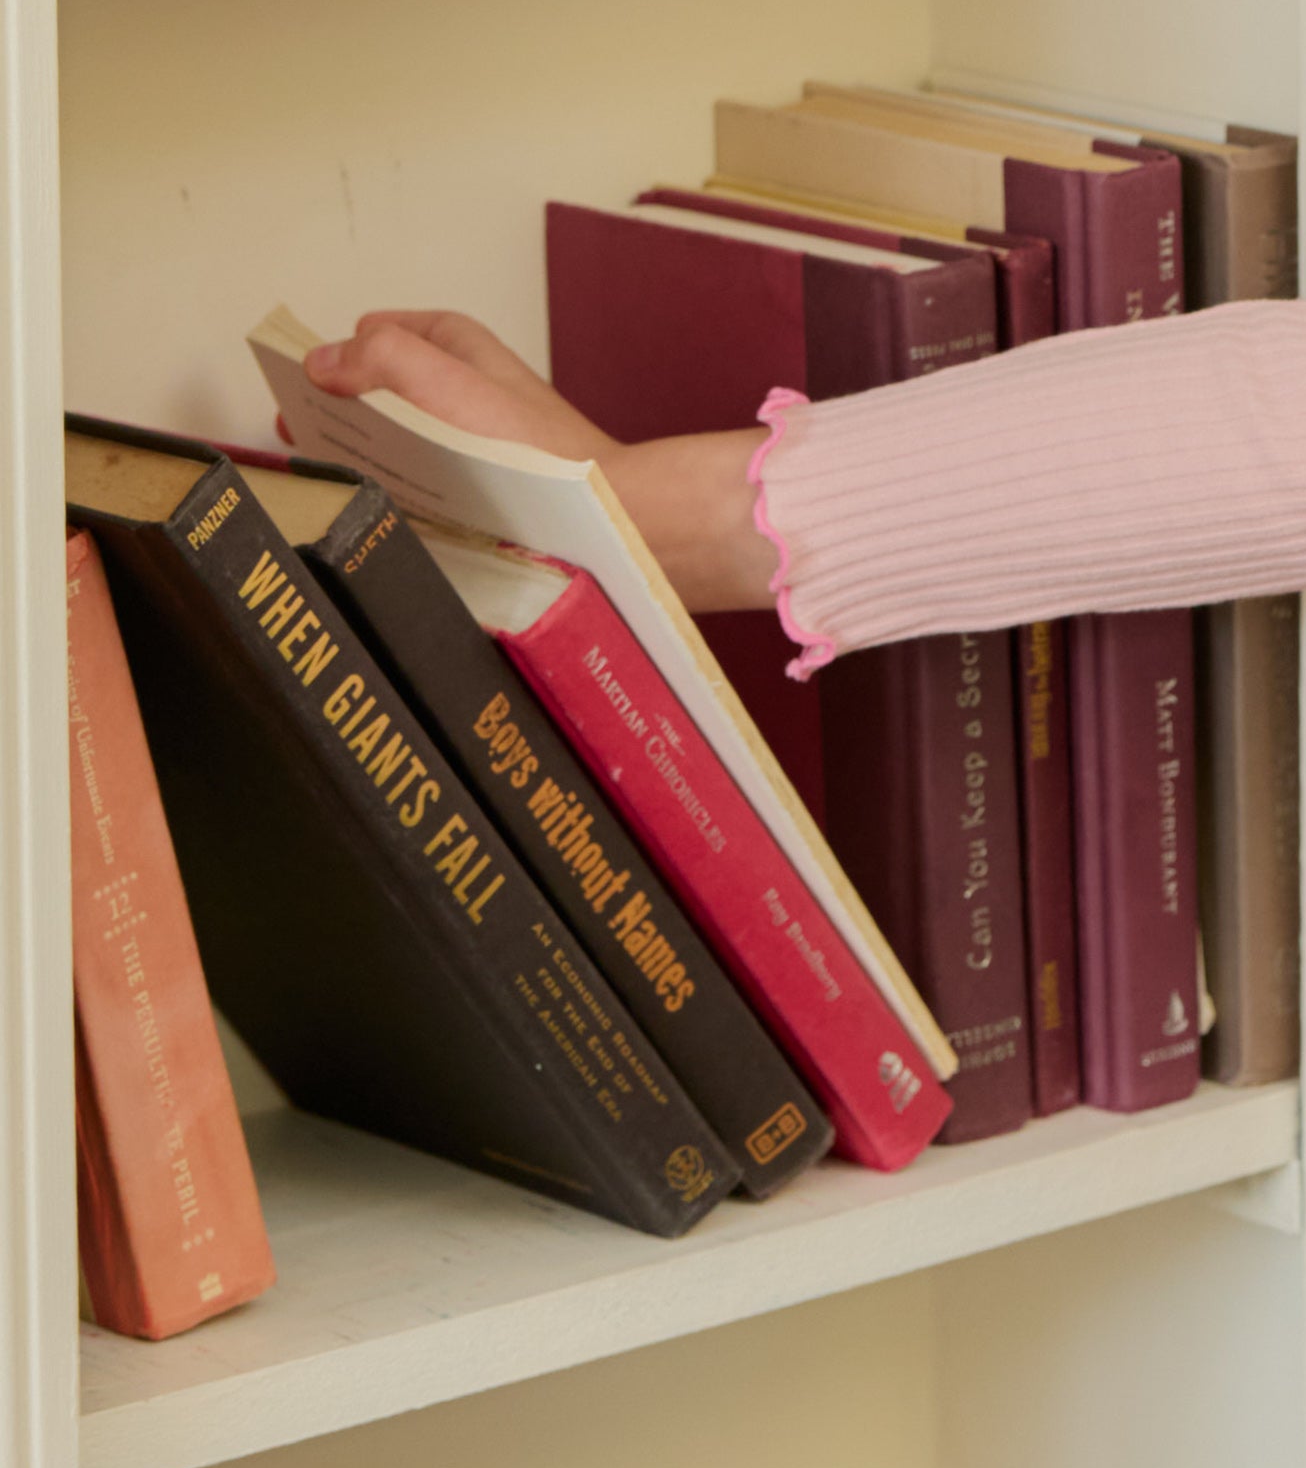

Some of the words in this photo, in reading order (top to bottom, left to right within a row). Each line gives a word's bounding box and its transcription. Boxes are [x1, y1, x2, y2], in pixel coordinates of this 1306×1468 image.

[186, 487, 242, 552] PANZNER
[238, 550, 341, 688] WHEN
[322, 672, 442, 829] GIANTS
[422, 812, 506, 927] FALL
[582, 644, 650, 740] MARTIAN
[644, 734, 729, 855] CHRONICLES
[964, 719, 984, 739] a
[1153, 676, 1179, 755] MATT
[76, 720, 102, 814] Unfortunate
[960, 751, 989, 832] Keep
[472, 691, 540, 789] Boys
[526, 776, 632, 914] without
[606, 890, 695, 1014] Names
[963, 836, 989, 900] You
[1157, 758, 1181, 917] BONDURANT
[107, 892, 134, 921] 12
[966, 904, 993, 971] Can
[121, 936, 147, 988] THE
[513, 973, 540, 1008] THE
[538, 1008, 599, 1088] AMERICAN
[596, 1088, 623, 1124] ERA
[531, 922, 553, 949] AN
[552, 947, 613, 1032] ECONOMIC
[612, 1030, 669, 1105] ROADMAP
[536, 967, 563, 1001] FOR
[563, 1000, 588, 1036] THE
[586, 1034, 615, 1072] END
[612, 1071, 634, 1094] OF
[132, 988, 186, 1159] PENULTITE
[170, 1157, 202, 1227] PERIL
